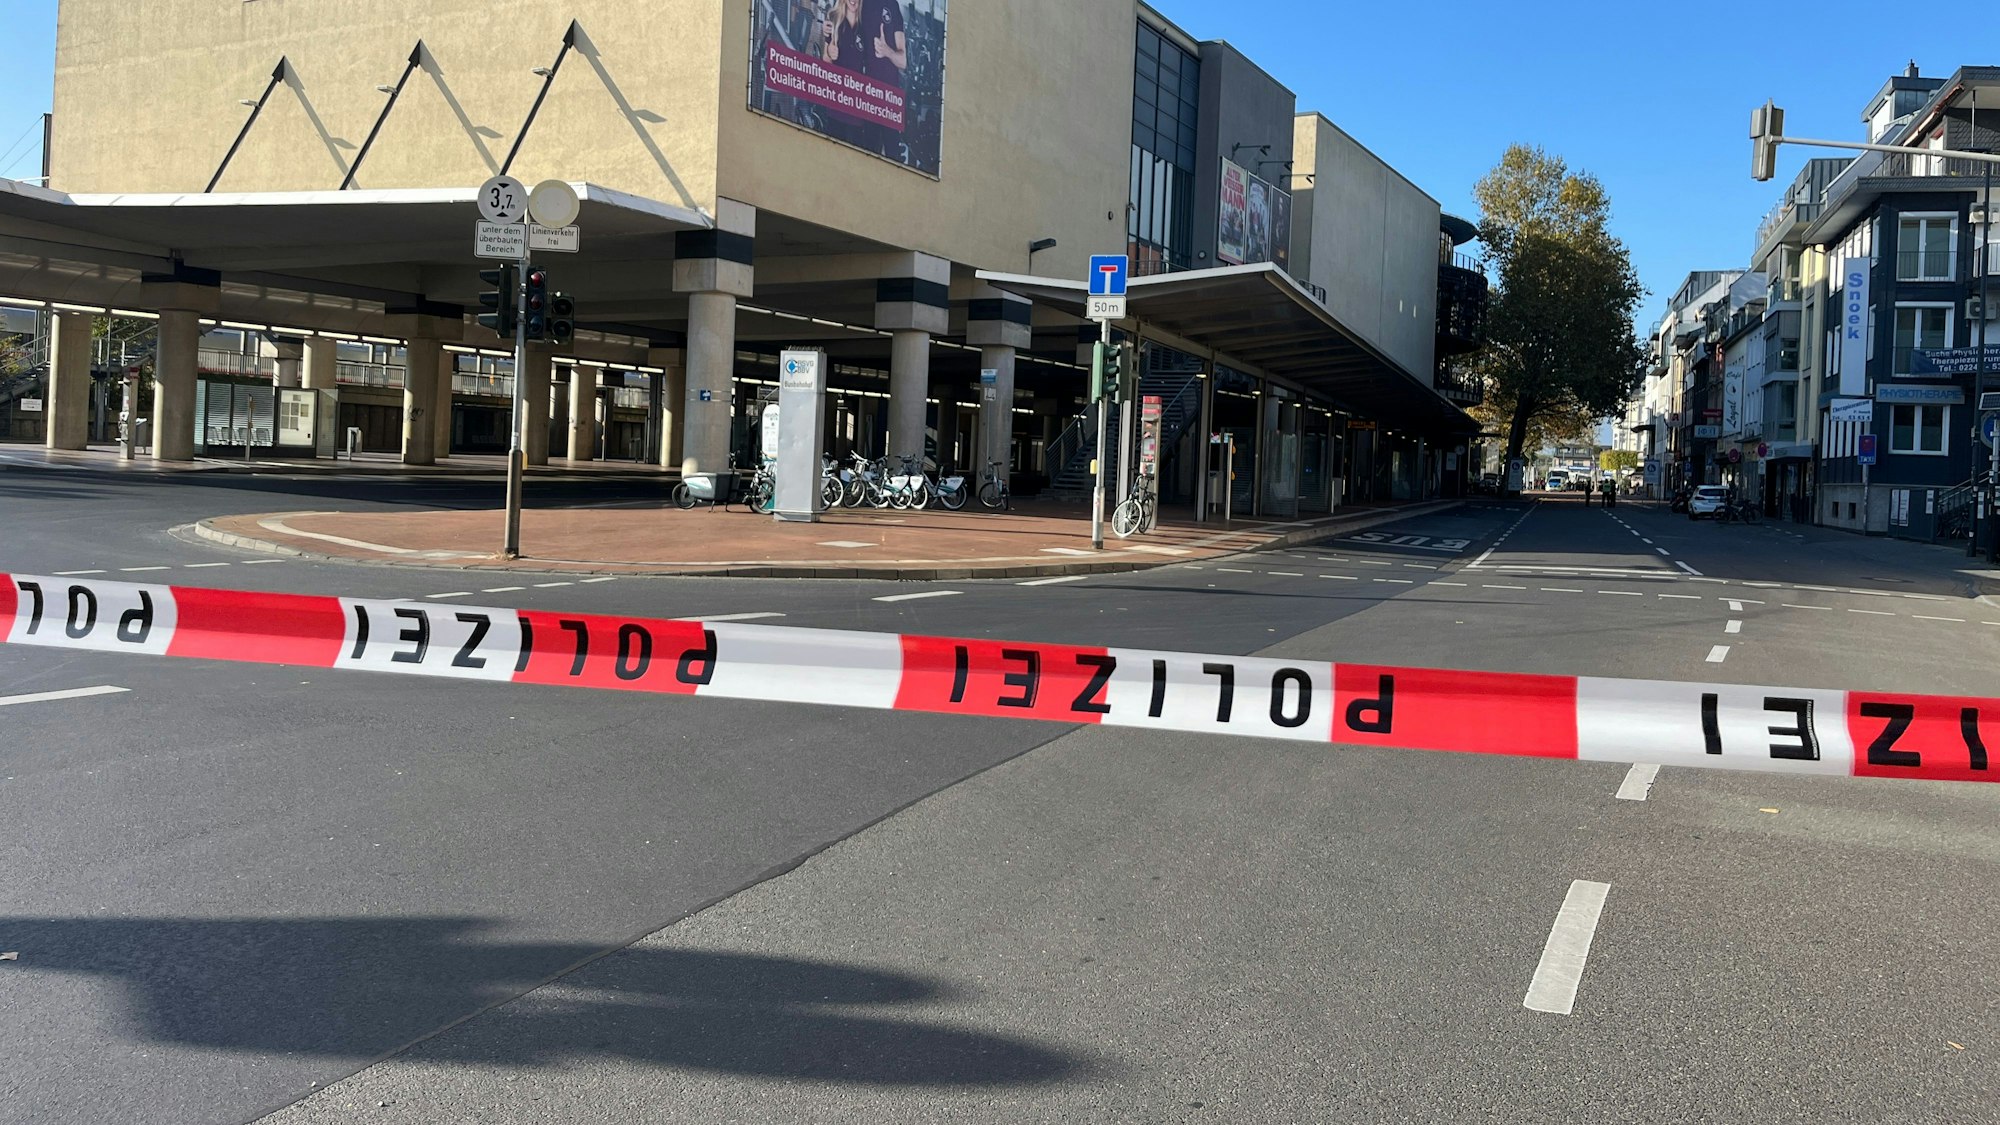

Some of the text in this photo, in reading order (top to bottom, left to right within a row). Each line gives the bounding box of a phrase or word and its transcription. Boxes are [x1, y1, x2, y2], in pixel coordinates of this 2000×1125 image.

[770, 48, 903, 106] Premiumfitness über dem Kino
[769, 67, 903, 123] Qualität macht den Unterschied
[482, 226, 521, 235] unter dem
[531, 226, 575, 237] Linienverkehr
[479, 235, 523, 244] überbauten
[547, 237, 559, 246] frei
[485, 244, 515, 254] Bereich
[1094, 302, 1119, 312] 50 m
[1847, 272, 1863, 339] Snoek
[1925, 350, 1950, 358] Suche
[1879, 388, 1961, 400] PHYSIOTHERAPIE
[350, 605, 717, 685] POLIZEI
[949, 645, 1394, 734] POLIZEI
